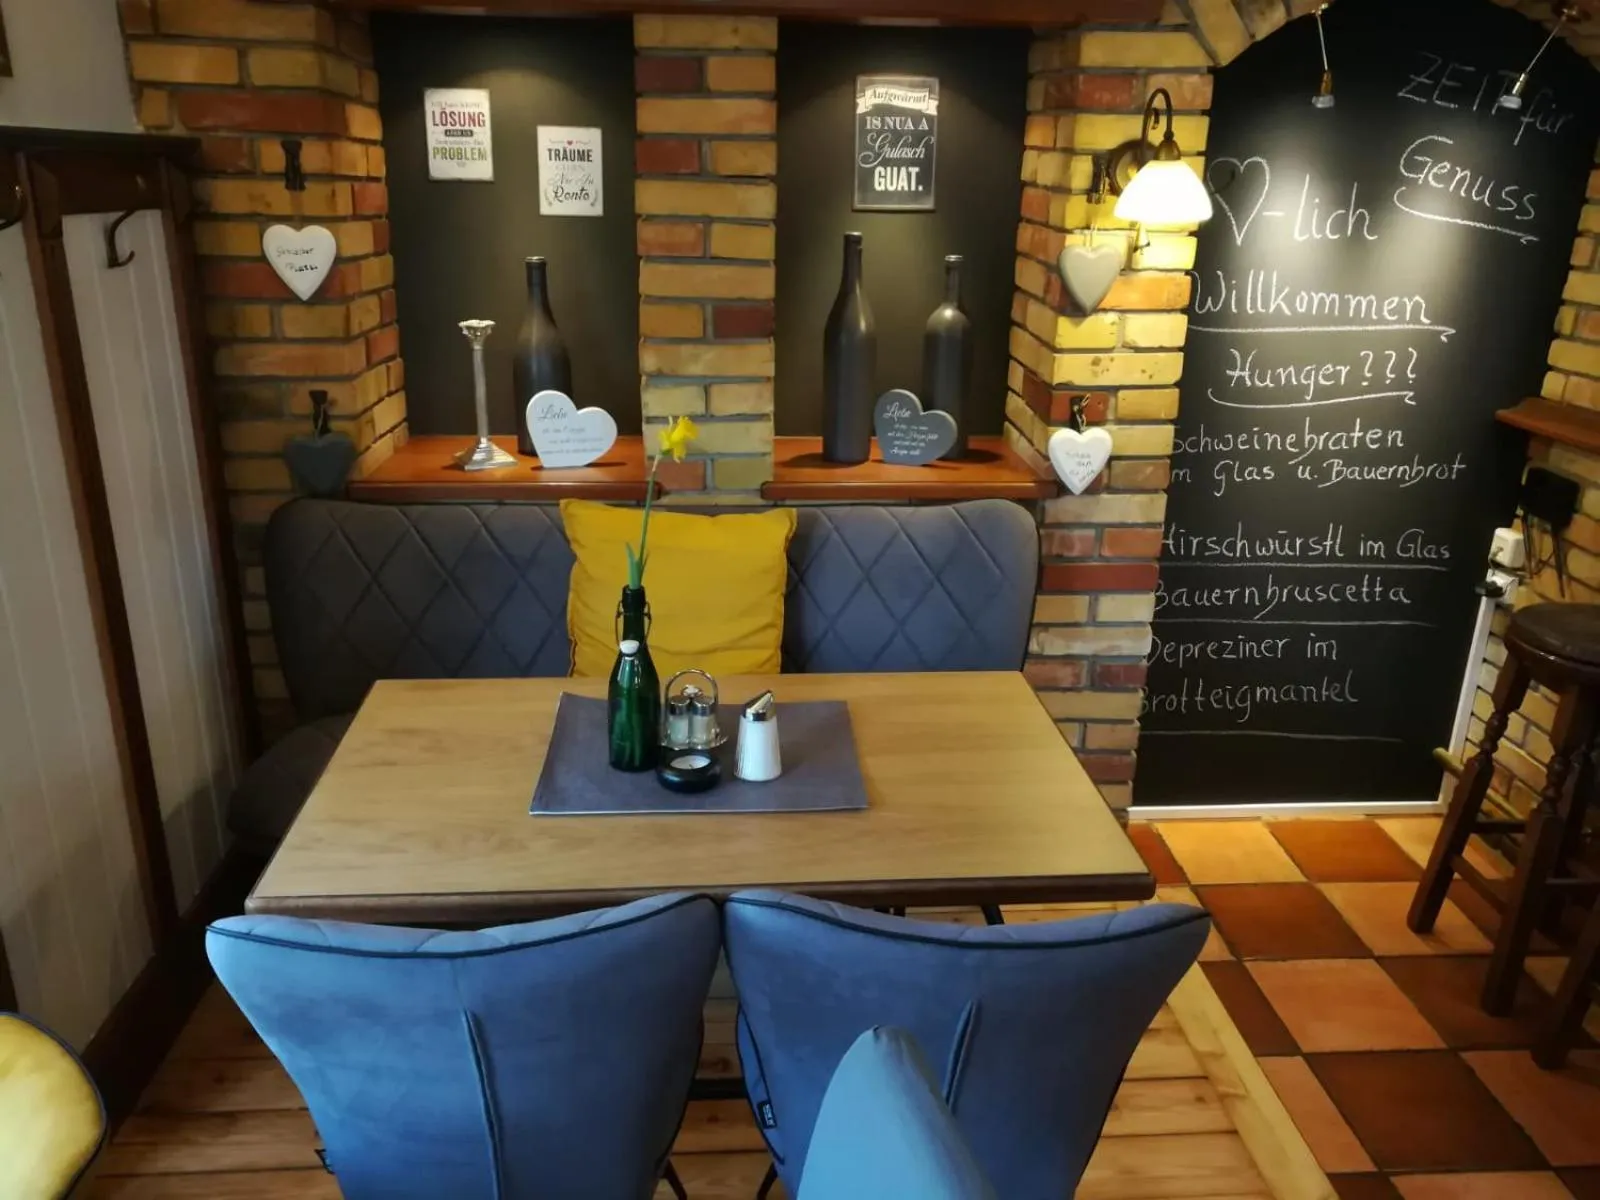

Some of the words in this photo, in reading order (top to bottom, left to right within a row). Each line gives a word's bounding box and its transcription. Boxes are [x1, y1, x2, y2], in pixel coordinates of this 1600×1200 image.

[1397, 51, 1520, 116] ZEIT
[431, 105, 486, 128] LÖSUNG
[864, 116, 881, 130] IS
[884, 116, 915, 130] NUA
[918, 117, 929, 130] A
[432, 146, 488, 162] PROBLEM
[546, 146, 594, 163] TRÄUME
[859, 132, 936, 168] Gulasch
[873, 166, 924, 192] GUAT.
[1399, 135, 1540, 220] Genuss
[1190, 269, 1432, 325] Willkommen
[1171, 468, 1192, 483] m
[1213, 460, 1275, 497] Glas
[1317, 453, 1467, 488] Bauernbrot
[1360, 533, 1386, 558] im
[1396, 528, 1451, 558] Glas
[1306, 632, 1338, 661] im
